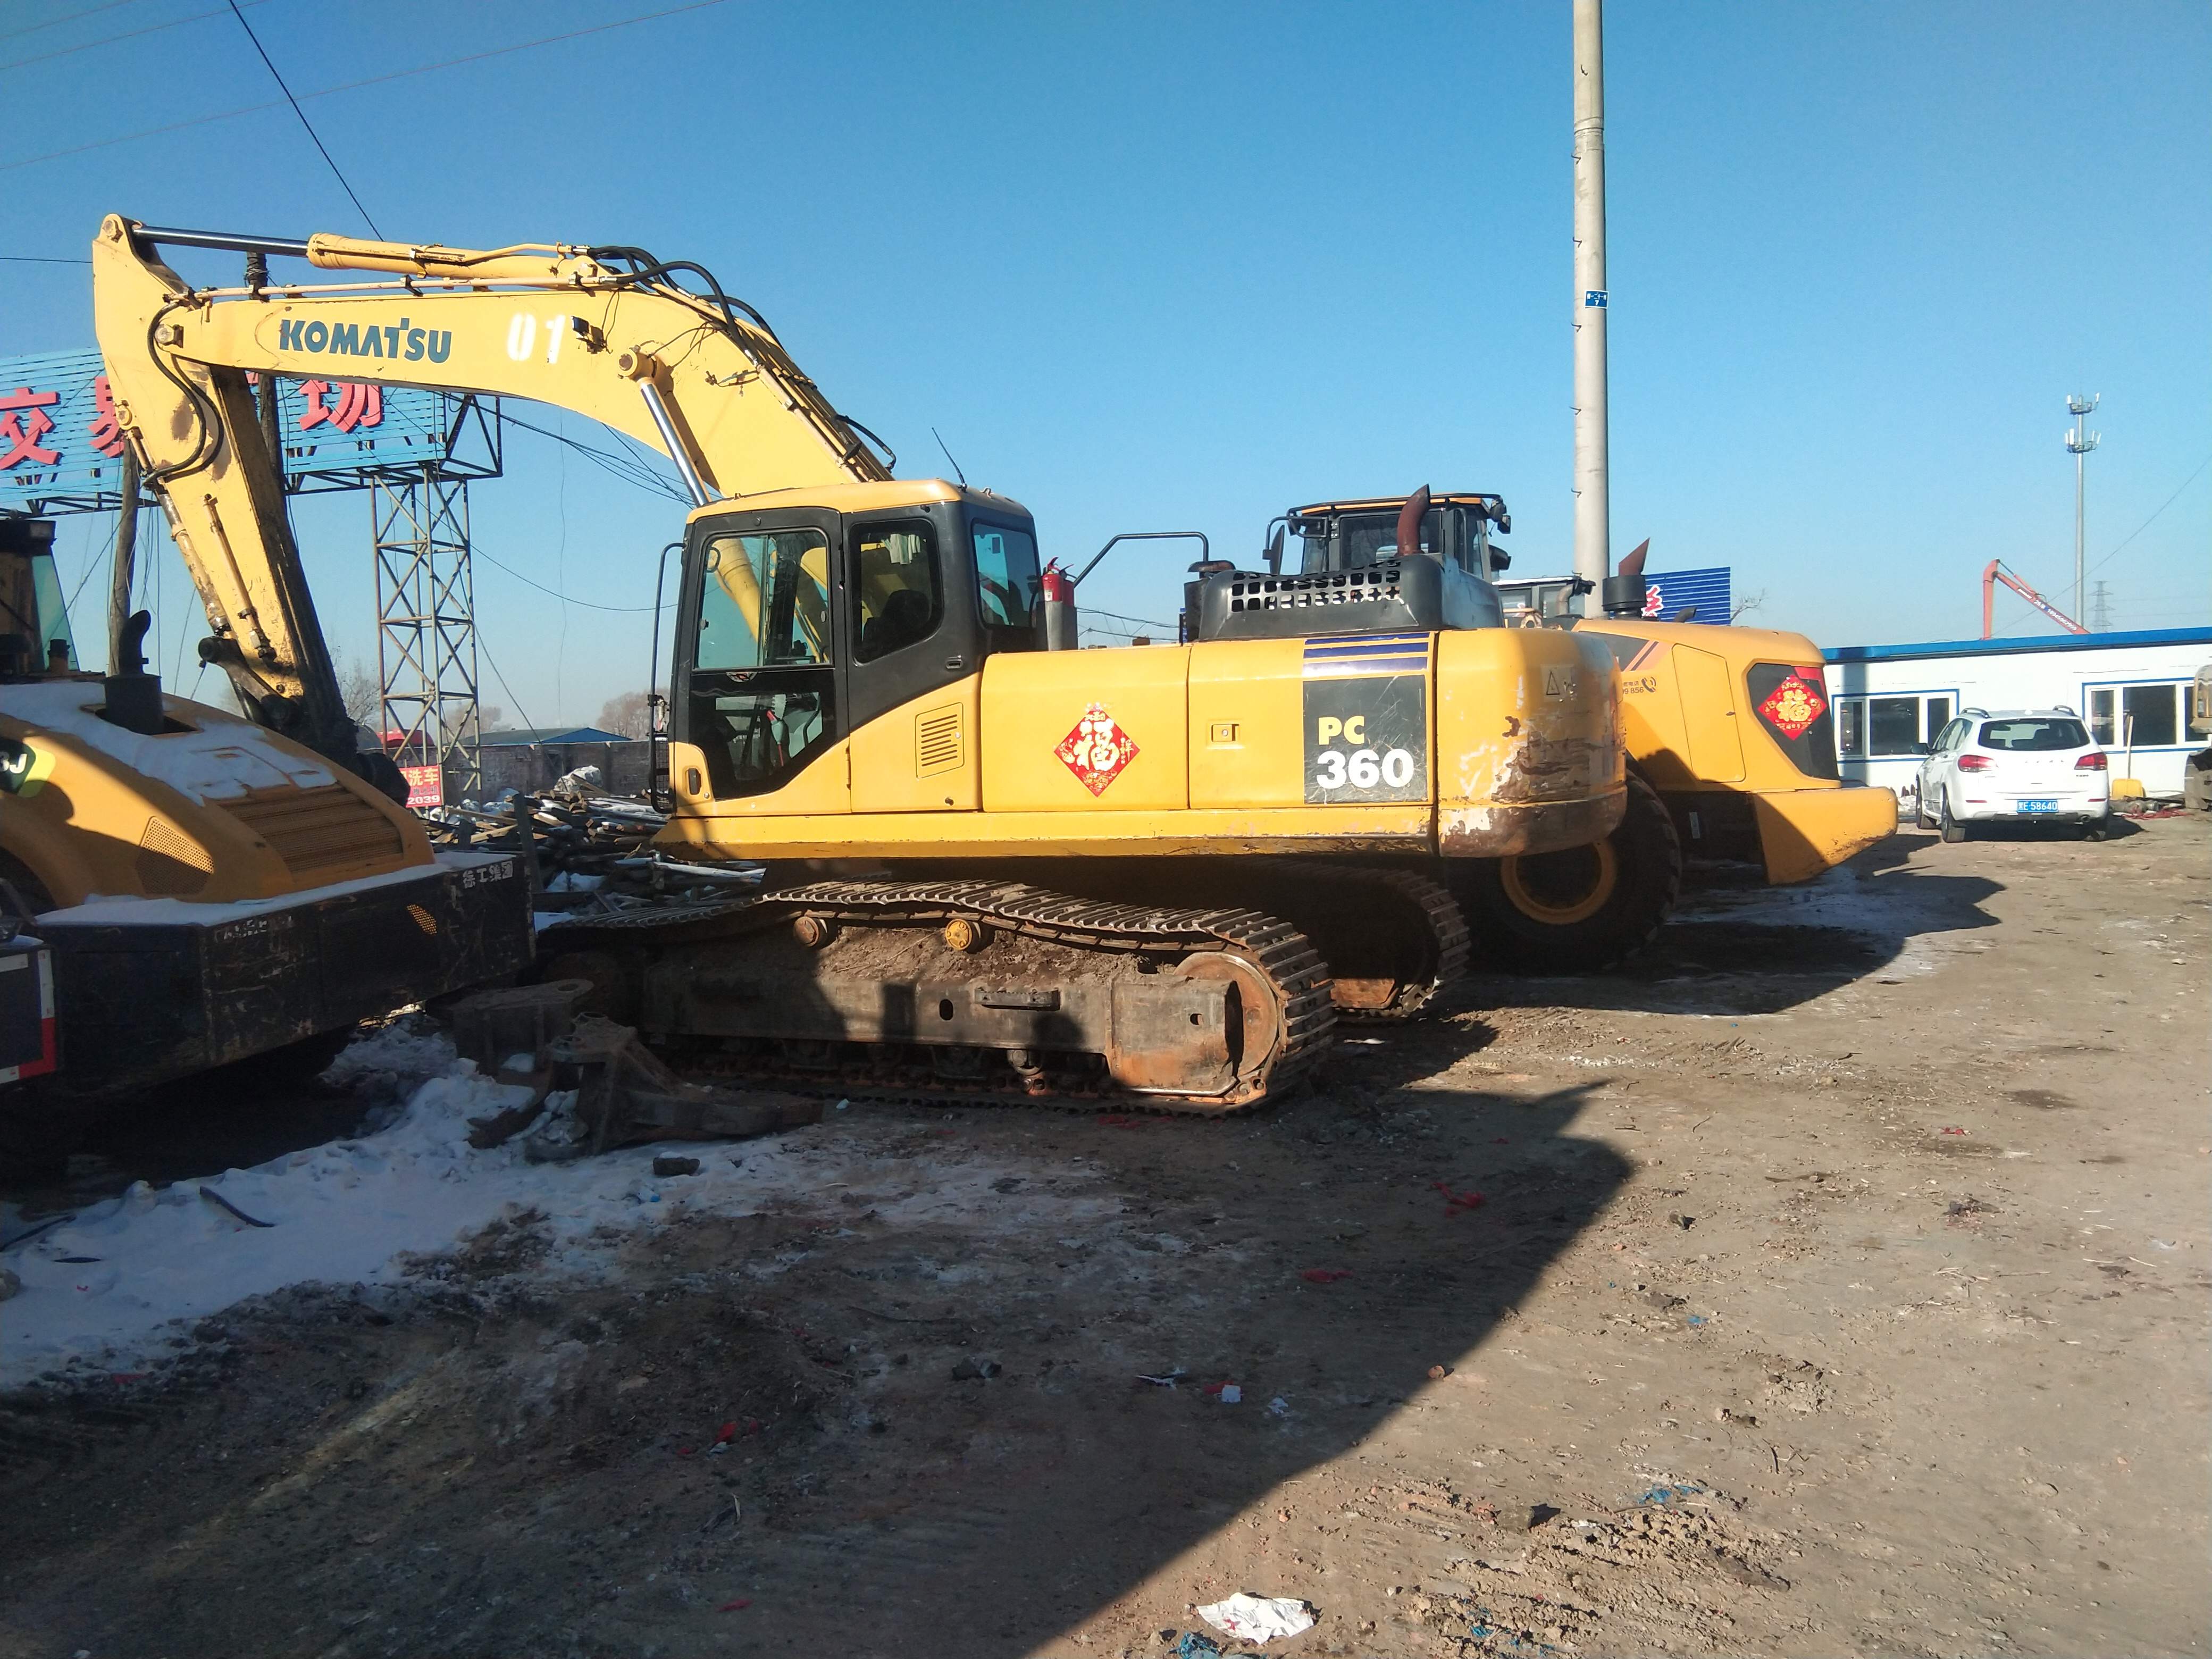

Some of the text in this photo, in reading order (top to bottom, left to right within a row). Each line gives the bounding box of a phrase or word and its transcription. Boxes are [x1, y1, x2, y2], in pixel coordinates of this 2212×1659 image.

[279, 317, 452, 364] KOMATSU
[507, 313, 566, 364] 01
[1775, 689, 1812, 722] 福
[1073, 718, 1120, 771] 福
[1318, 715, 1365, 745] PC
[400, 767, 439, 786] 洗车
[1316, 748, 1414, 789] 360
